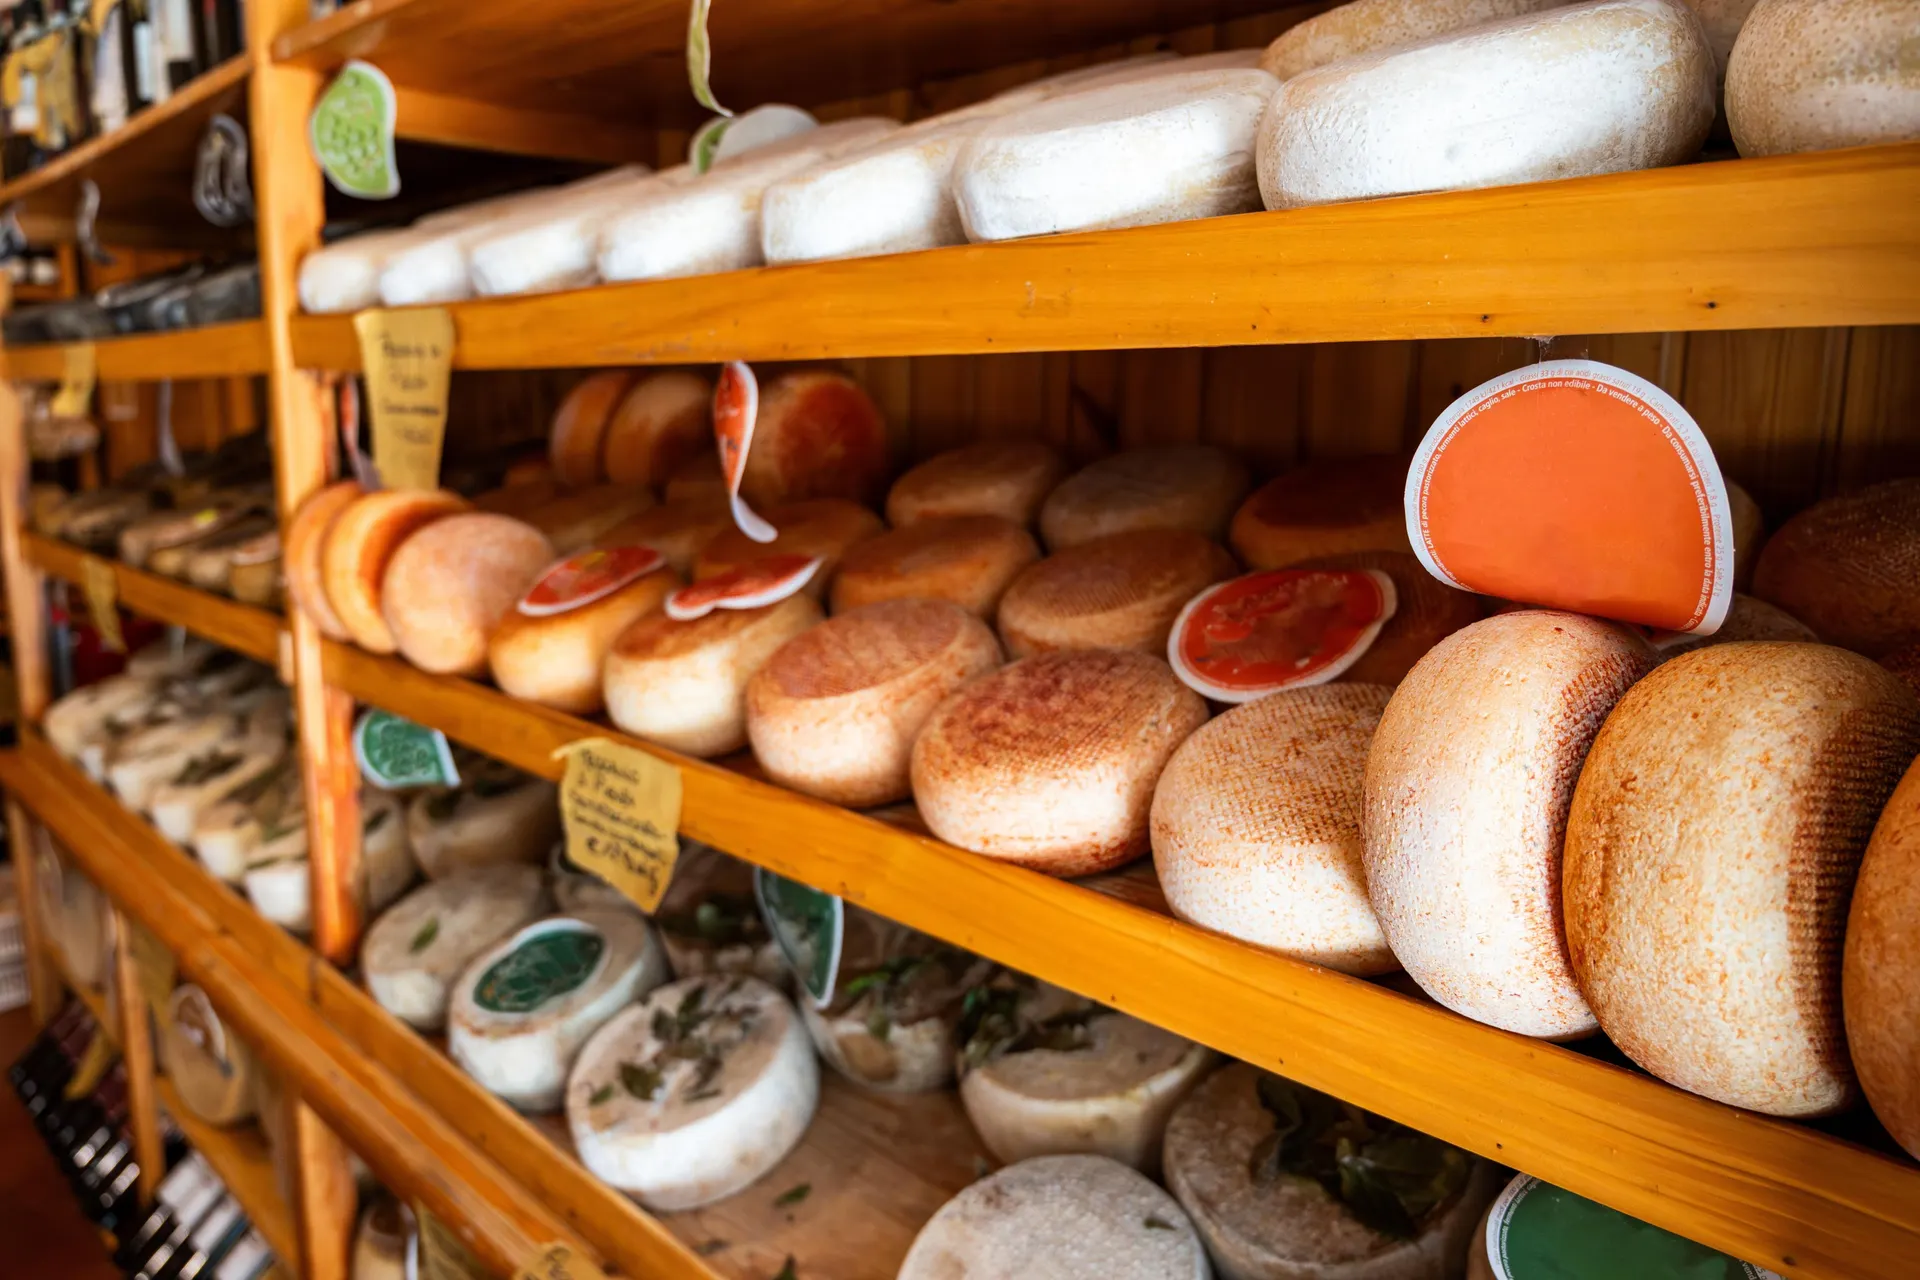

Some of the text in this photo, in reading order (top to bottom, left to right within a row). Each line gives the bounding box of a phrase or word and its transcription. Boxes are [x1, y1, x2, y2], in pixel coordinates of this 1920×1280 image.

[1521, 380, 1546, 393] Crosta
[1547, 380, 1563, 388] non
[1564, 378, 1591, 390] edibile
[1595, 383, 1608, 395] Da
[1500, 387, 1516, 400] sale
[1608, 388, 1639, 409] vendere
[1478, 396, 1501, 412] caglio,
[1636, 404, 1645, 413] a
[1416, 463, 1425, 475] 100
[1501, 377, 1514, 389] kcal
[1519, 371, 1539, 382] Grassi
[1540, 369, 1549, 378] 33
[1592, 371, 1612, 383] grassi
[1457, 408, 1479, 428] lattici,
[1640, 408, 1661, 425] peso
[1437, 424, 1461, 453] fermenti
[1661, 425, 1673, 439] Da
[1670, 437, 1700, 481] consumarsi
[1422, 453, 1442, 496] pastorizzato,
[1421, 495, 1429, 520] pecora
[1690, 479, 1712, 545] preferibilmente
[1420, 520, 1428, 528] di
[1422, 529, 1435, 549] LATTE
[1704, 546, 1713, 568] entro
[1703, 569, 1713, 577] la
[1701, 577, 1712, 594] data
